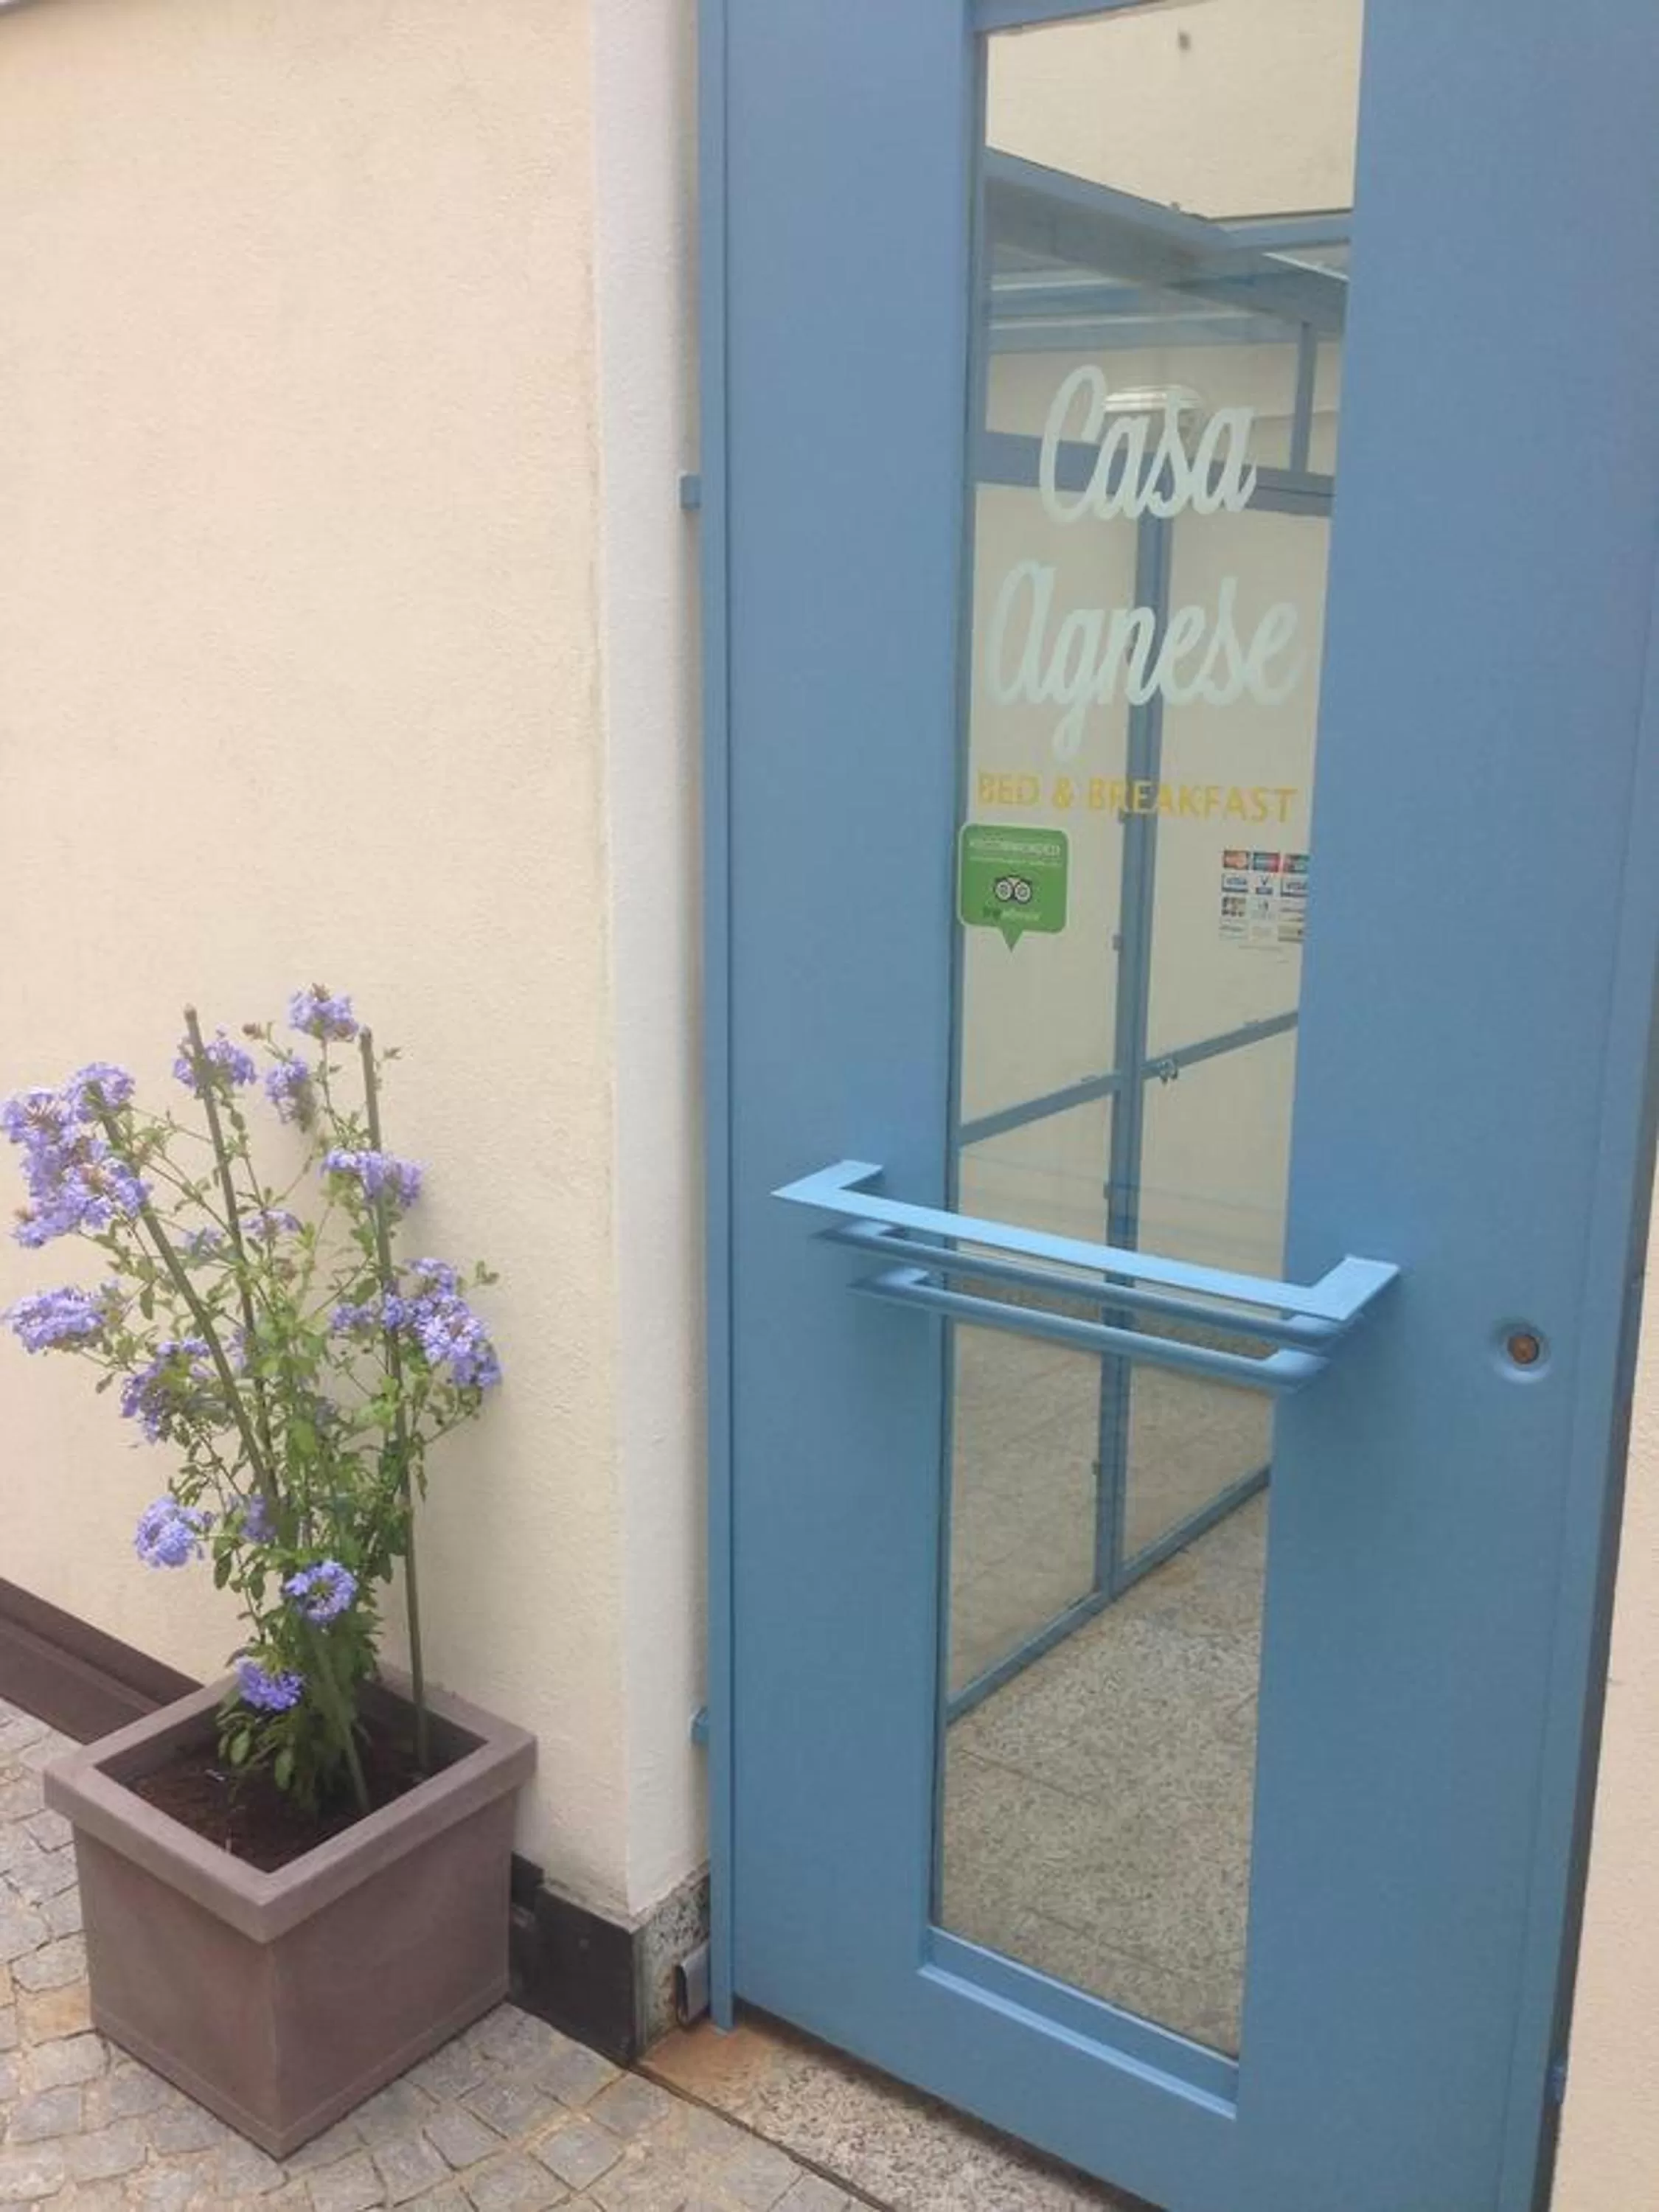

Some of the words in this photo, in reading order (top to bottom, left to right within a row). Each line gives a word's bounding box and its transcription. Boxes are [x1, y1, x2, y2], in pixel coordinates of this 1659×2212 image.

[1040, 364, 1257, 523] Casa
[984, 559, 1304, 762] Agnese
[978, 771, 1040, 806] BED
[1052, 776, 1074, 808] &
[1088, 778, 1298, 823] BREAKFAST
